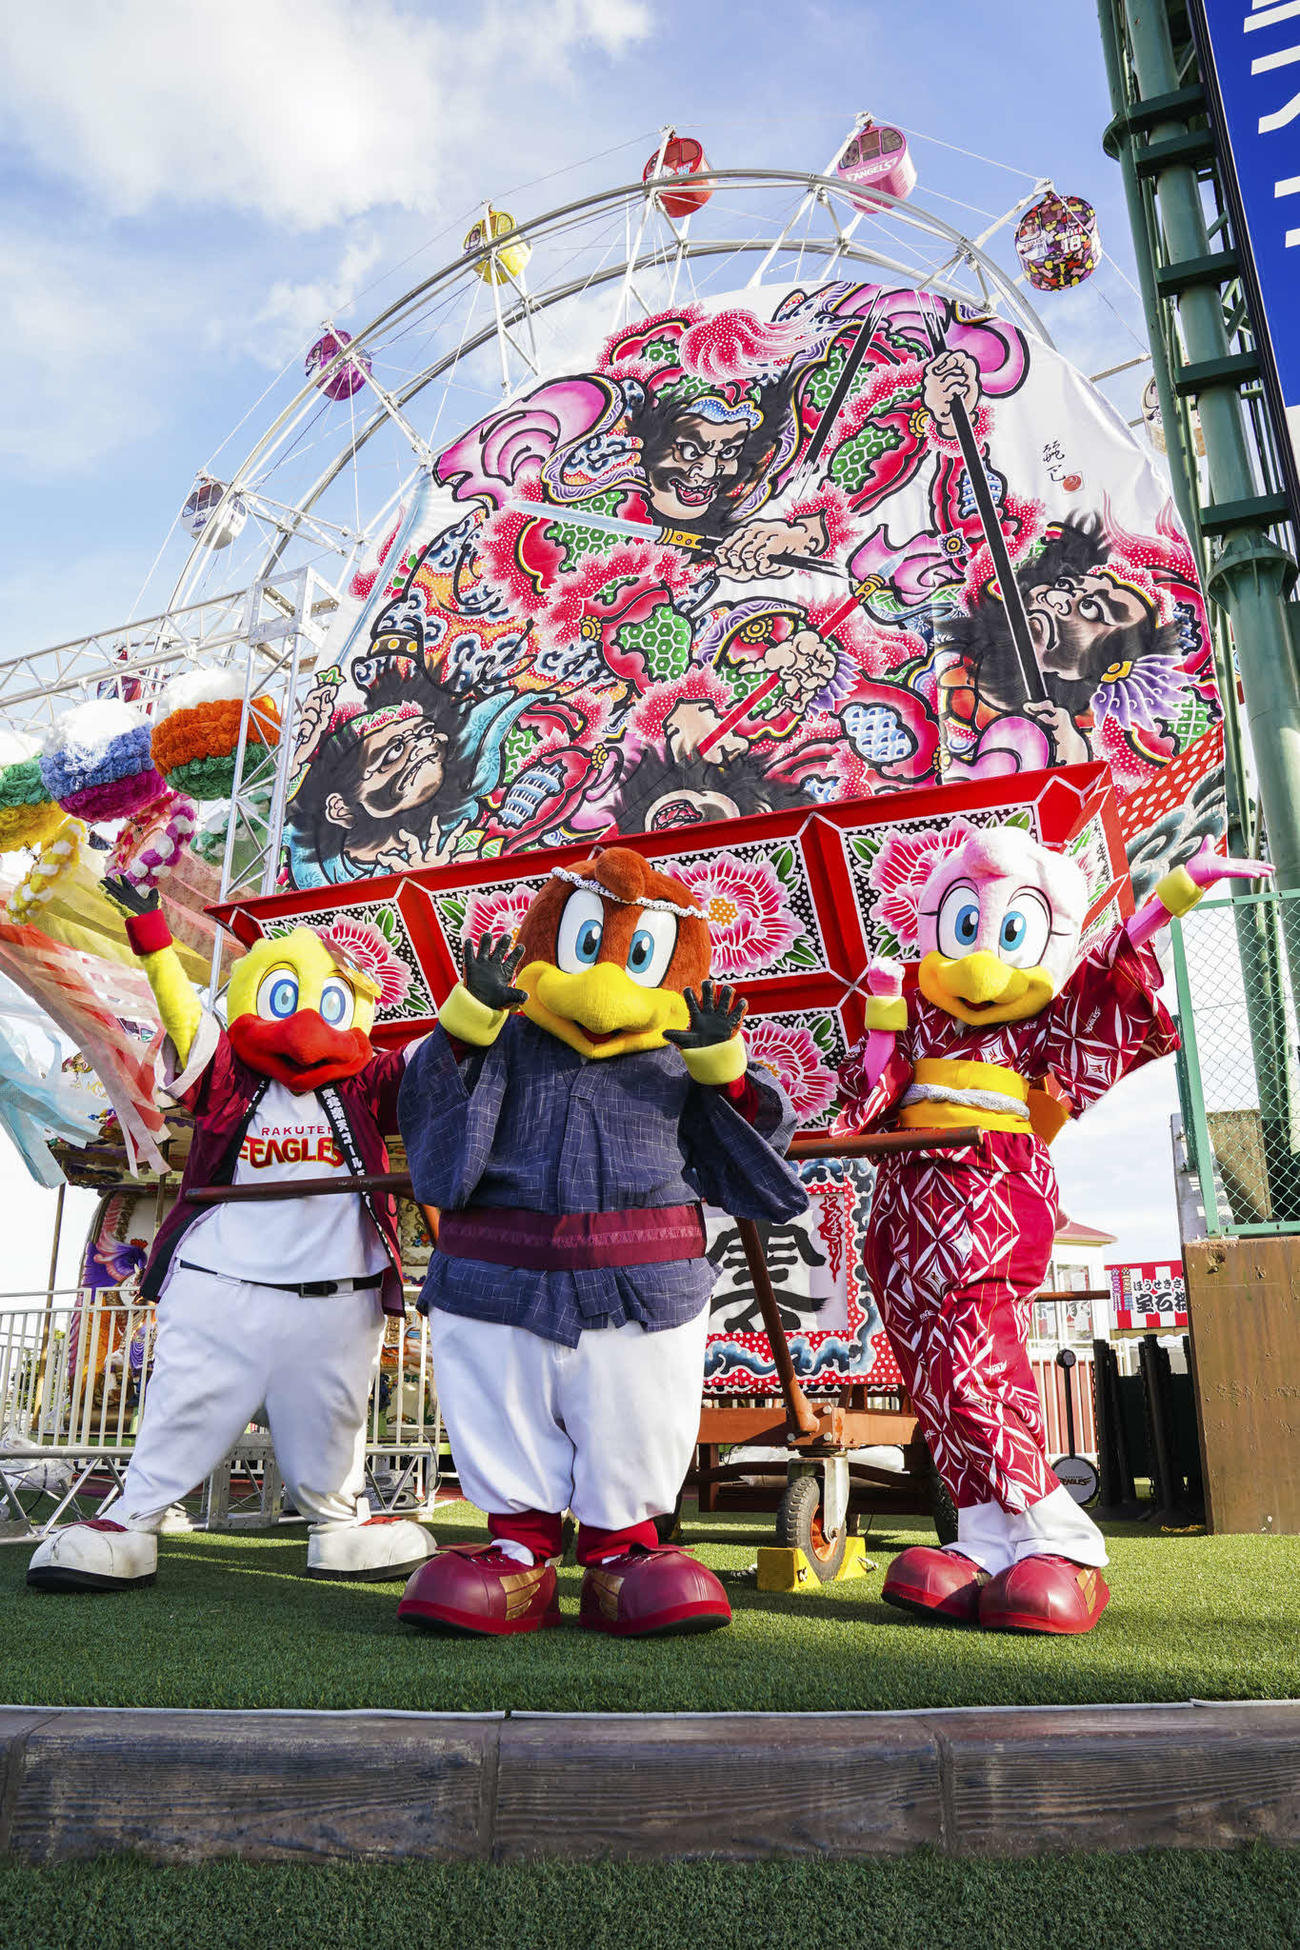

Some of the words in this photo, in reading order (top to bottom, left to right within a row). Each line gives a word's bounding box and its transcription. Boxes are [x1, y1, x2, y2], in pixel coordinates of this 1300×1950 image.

[1060, 234, 1081, 255] 18
[239, 1136, 345, 1169] EAGLES
[821, 1196, 841, 1271] 七夕まつり
